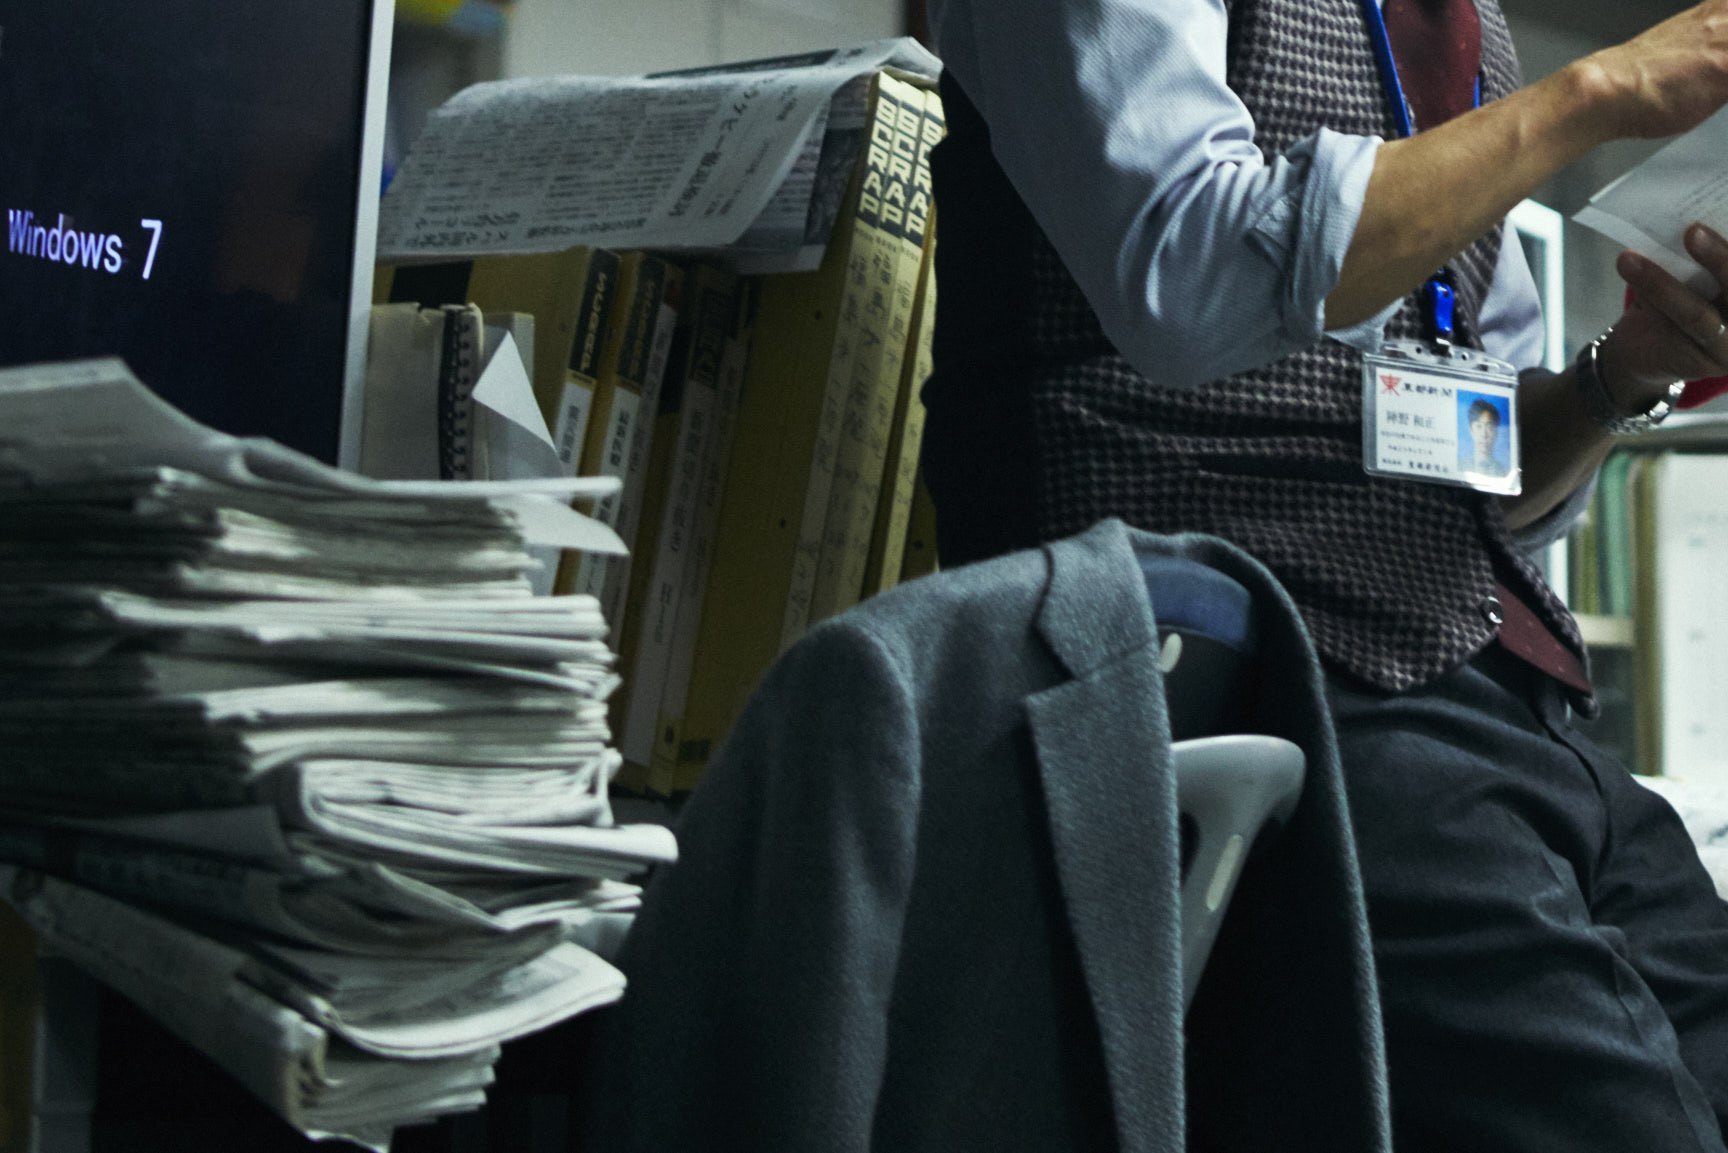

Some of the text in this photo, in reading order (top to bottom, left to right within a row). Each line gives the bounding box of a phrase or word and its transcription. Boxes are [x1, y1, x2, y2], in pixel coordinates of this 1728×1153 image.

[858, 96, 898, 214] SCRAP
[881, 106, 920, 226] SCRAP
[905, 118, 945, 236] SCRAP
[8, 208, 162, 279] Windows 7
